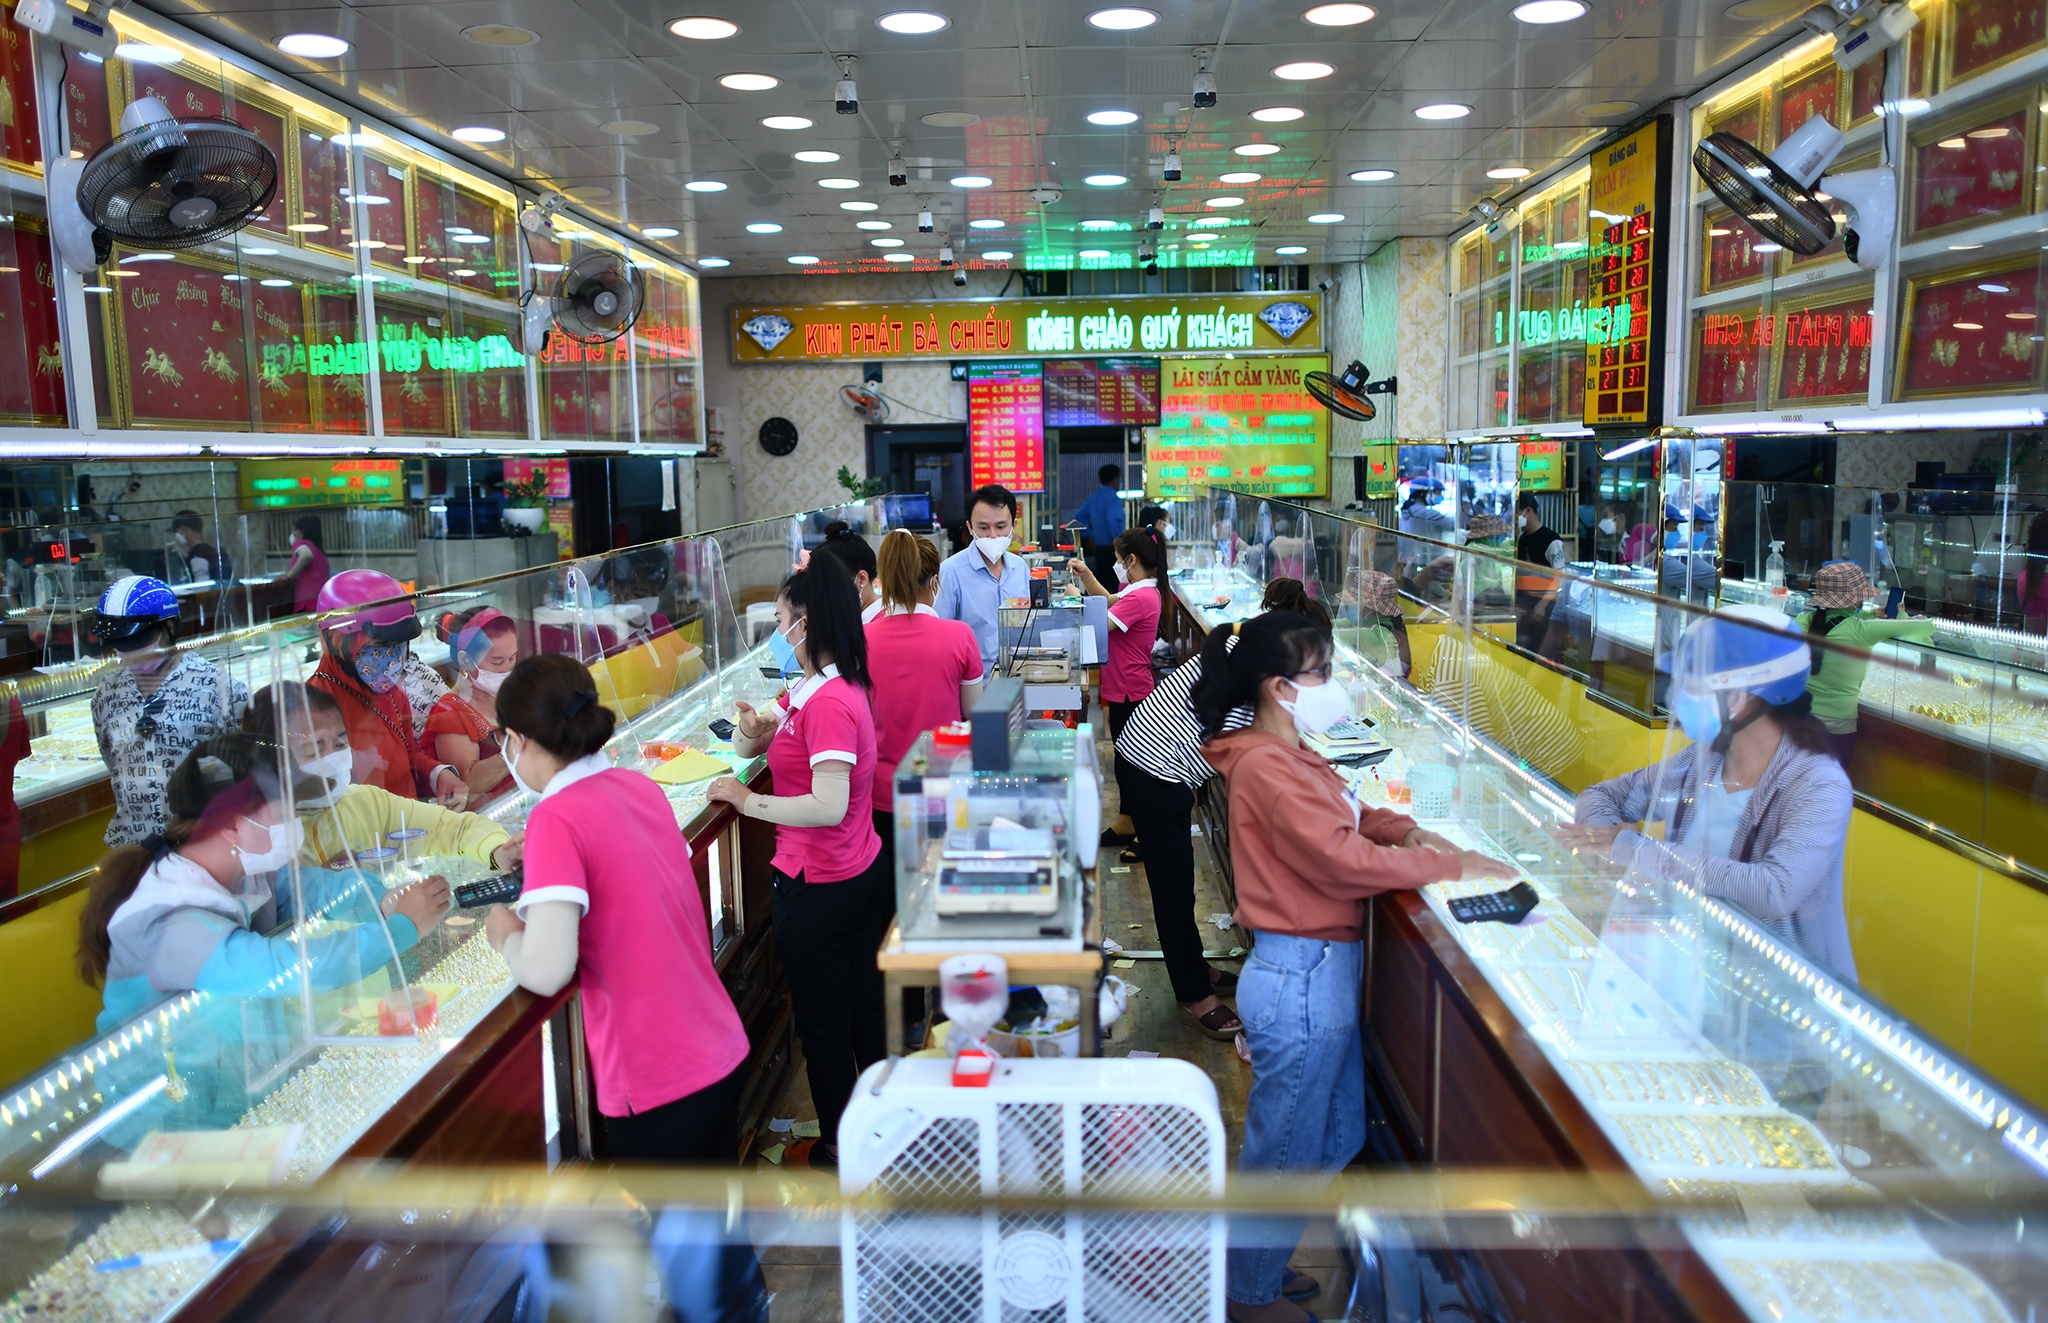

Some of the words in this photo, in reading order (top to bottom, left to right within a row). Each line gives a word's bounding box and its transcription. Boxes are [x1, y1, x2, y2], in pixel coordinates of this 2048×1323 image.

[1626, 138, 1638, 158] GIÁ
[1631, 267, 1643, 287] 28
[805, 323, 844, 354] KIM
[850, 314, 904, 353] PHÁT
[912, 313, 942, 352] BÀ
[948, 305, 1012, 351] CHIỂU
[1027, 309, 1075, 351] KÍNH
[1079, 307, 1134, 350] CHÀO
[1140, 306, 1181, 351] QUÝ
[1186, 305, 1255, 349] KHÁCH
[1173, 366, 1195, 388] LÃI
[1198, 363, 1231, 388] SUẤT
[1234, 361, 1263, 387] CẦM
[1263, 365, 1301, 386] VÀNG
